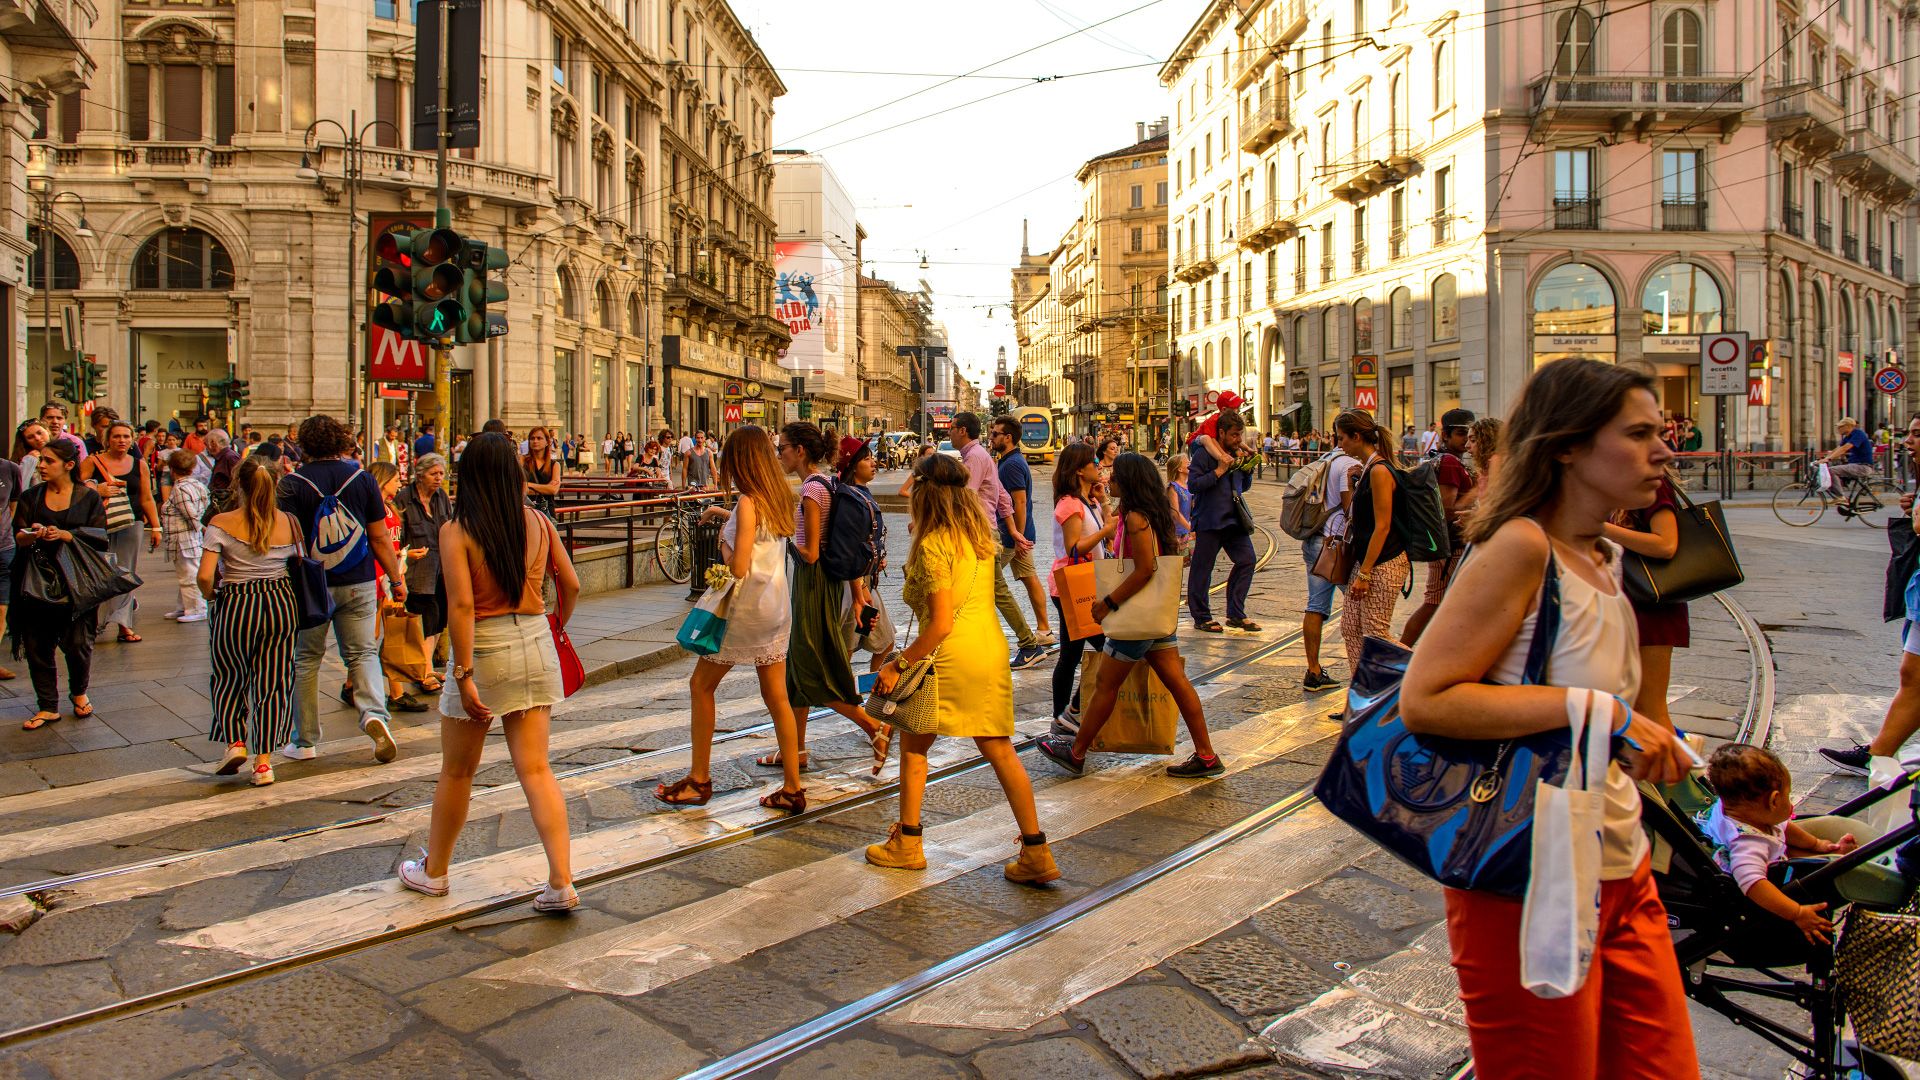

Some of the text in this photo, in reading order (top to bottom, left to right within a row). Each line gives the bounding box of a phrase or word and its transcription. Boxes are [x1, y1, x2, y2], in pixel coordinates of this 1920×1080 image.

[776, 301, 807, 319] ALDI
[1553, 337, 1598, 345] blue sand
[1661, 337, 1680, 345] blue
[167, 360, 205, 370] ZARA
[1357, 392, 1375, 406] M
[726, 408, 740, 419] M
[1118, 690, 1167, 703] RIMARK
